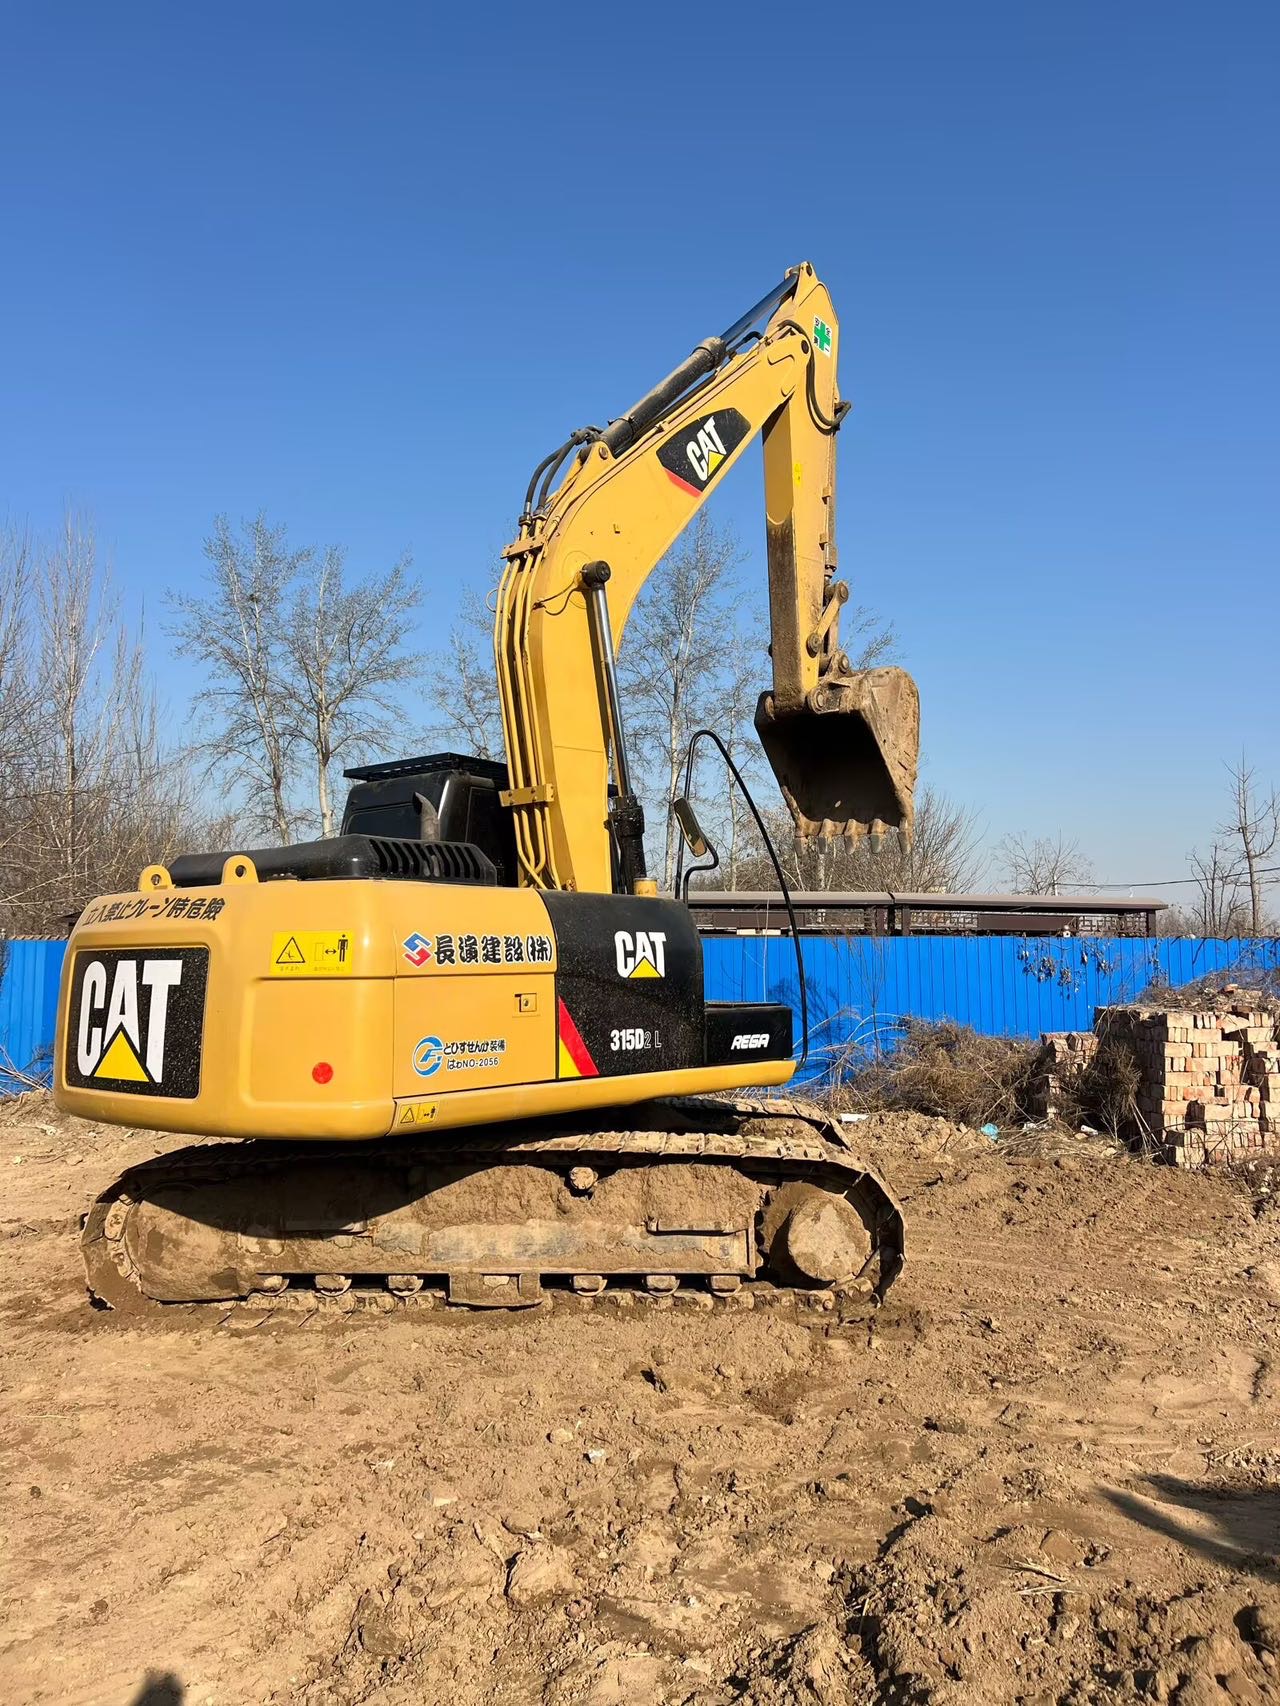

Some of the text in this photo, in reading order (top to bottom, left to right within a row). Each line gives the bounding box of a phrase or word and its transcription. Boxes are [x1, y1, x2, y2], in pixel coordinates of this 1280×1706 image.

[686, 415, 727, 481] CAT
[614, 930, 667, 978] CAT
[77, 960, 182, 1083] CAT
[731, 1033, 770, 1050] REGA
